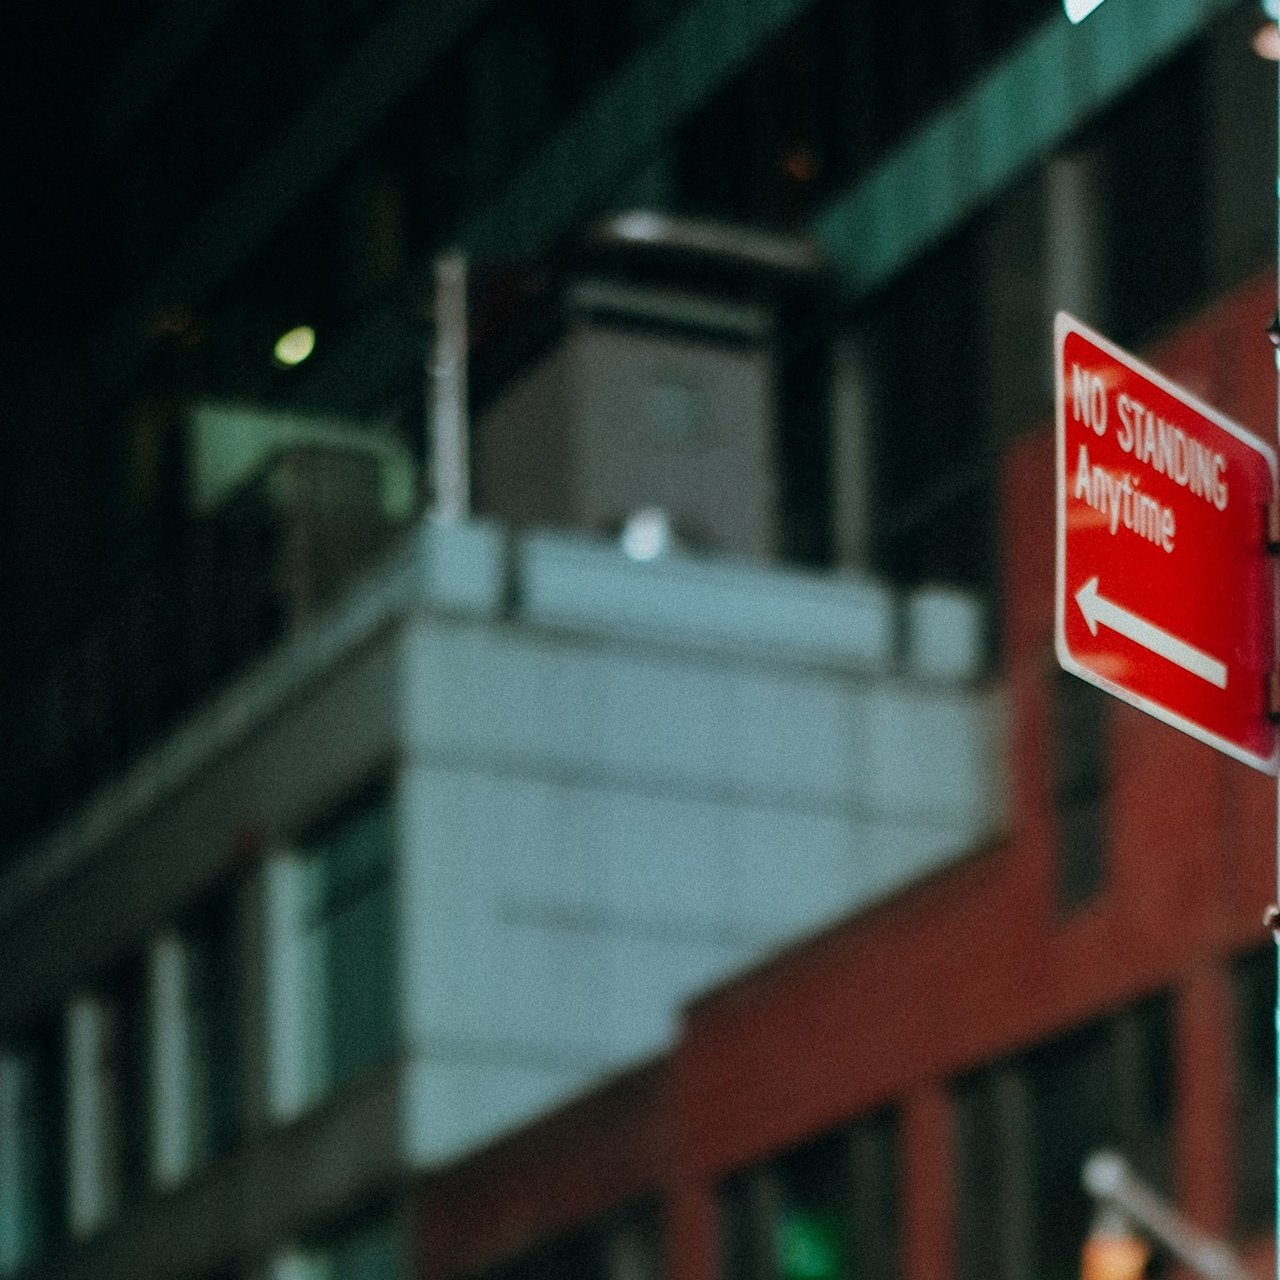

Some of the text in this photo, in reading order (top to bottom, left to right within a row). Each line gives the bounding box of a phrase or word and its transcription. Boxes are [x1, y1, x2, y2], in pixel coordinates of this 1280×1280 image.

[1072, 363, 1224, 508] NO STANDING
[1074, 441, 1174, 554] Anytime
